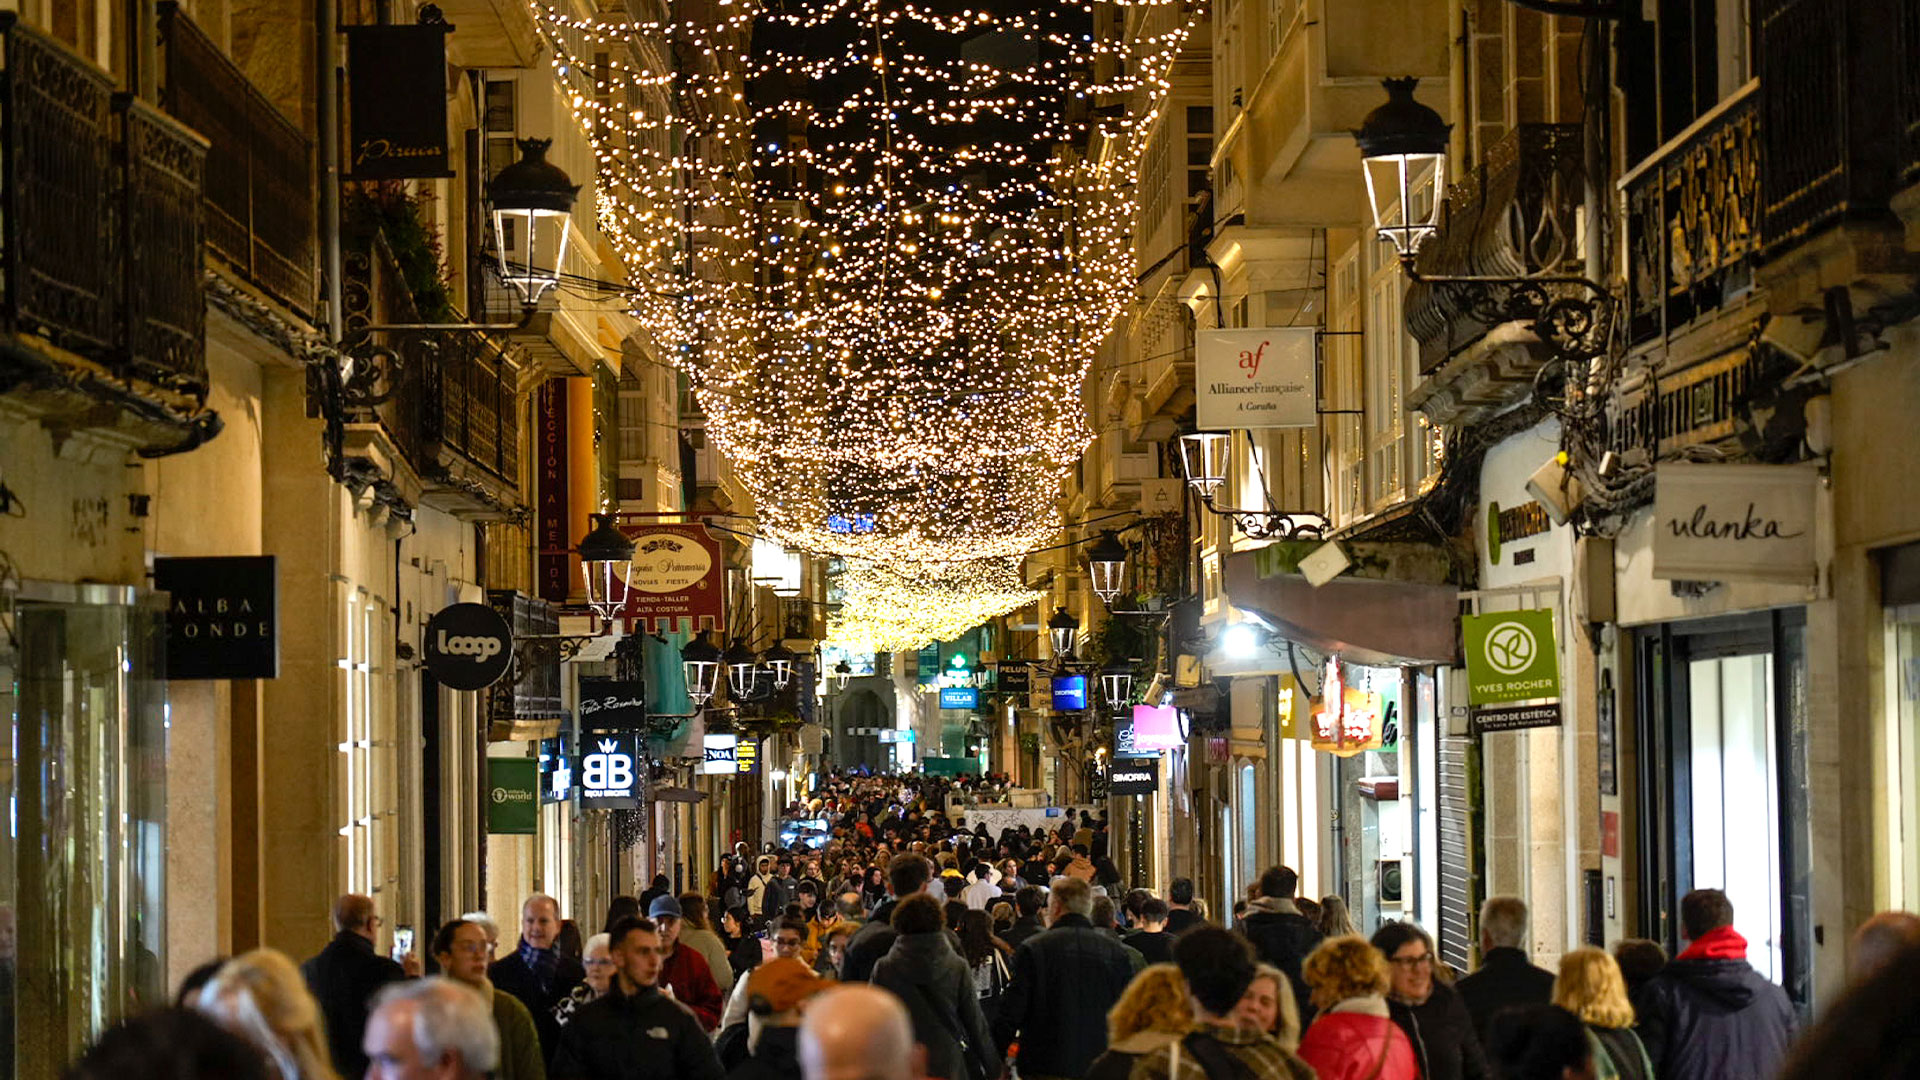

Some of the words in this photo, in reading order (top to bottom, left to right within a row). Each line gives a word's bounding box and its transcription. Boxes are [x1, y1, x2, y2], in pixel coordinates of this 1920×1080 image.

[1239, 341, 1270, 379] af
[1208, 382, 1304, 395] AllianceFrançaise
[1236, 402, 1243, 412] A
[1246, 402, 1277, 412] Coruña
[1667, 502, 1806, 541] ulanka
[175, 598, 252, 614] ALBA
[636, 605, 654, 614] ALTA
[655, 604, 689, 614] COSTURA
[1475, 684, 1502, 693] YVES
[1506, 679, 1553, 691] ROCHER
[1476, 713, 1508, 723] CENTRO
[1509, 712, 1520, 720] DE
[1520, 708, 1558, 719] ESTÉTICA
[708, 749, 733, 760] NOA
[1112, 772, 1152, 783] SIMORRA
